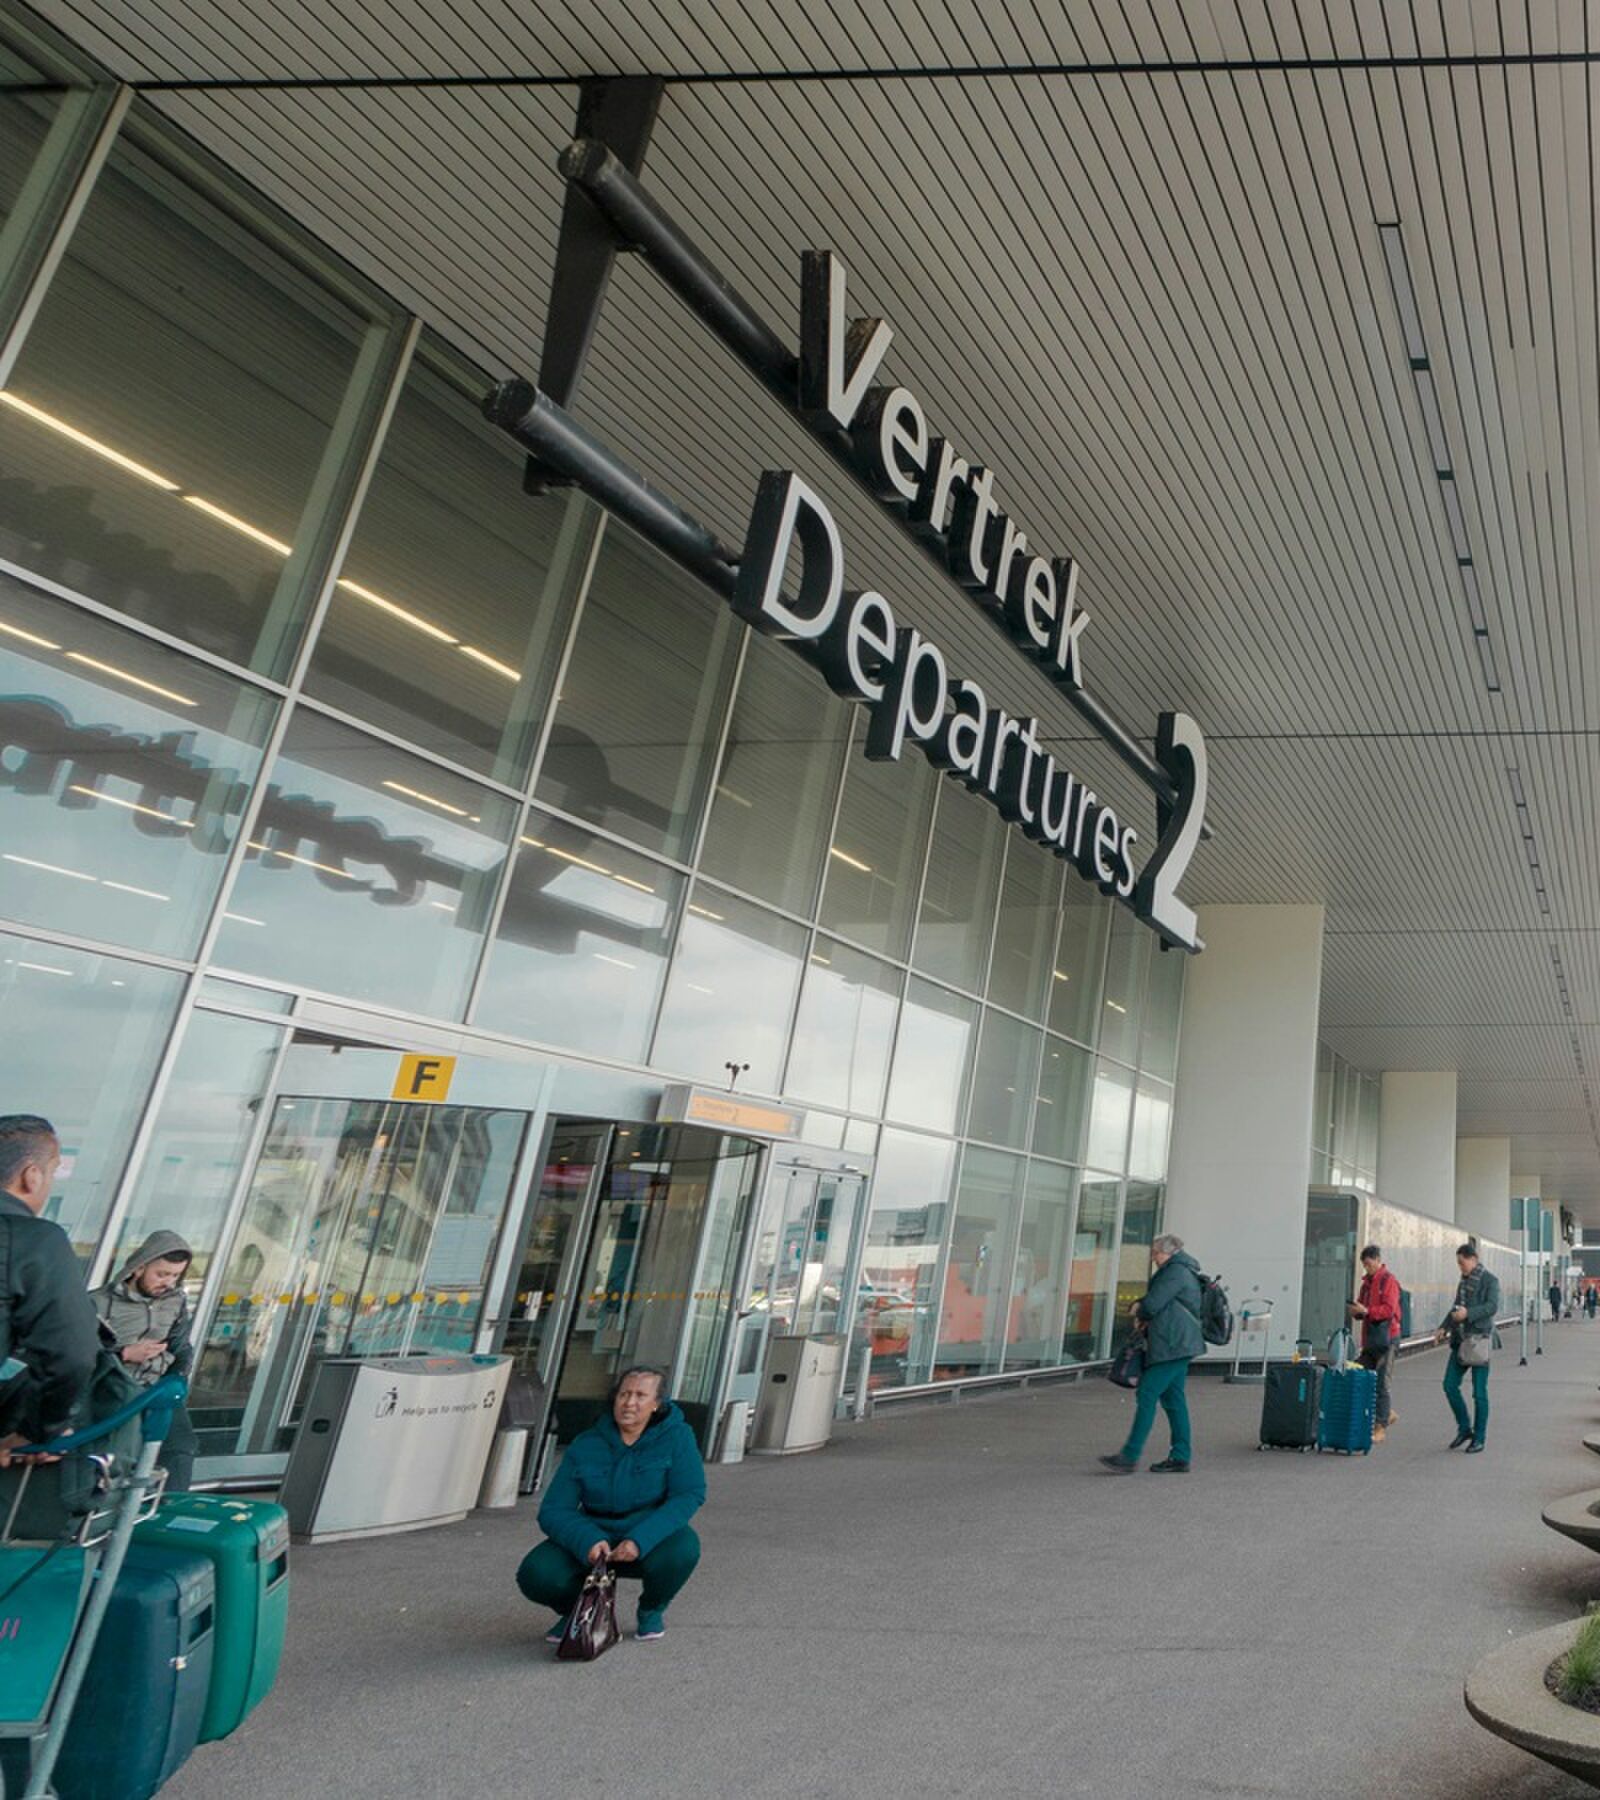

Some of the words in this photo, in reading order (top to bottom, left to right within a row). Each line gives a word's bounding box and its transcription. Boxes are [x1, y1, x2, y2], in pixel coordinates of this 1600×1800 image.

[802, 249, 1090, 690] Vertrek
[735, 470, 1138, 897] Departures
[1142, 712, 1207, 951] 2
[410, 1060, 440, 1095] F
[402, 1405, 425, 1417] Help
[427, 1407, 439, 1415] us
[440, 1404, 450, 1413] to
